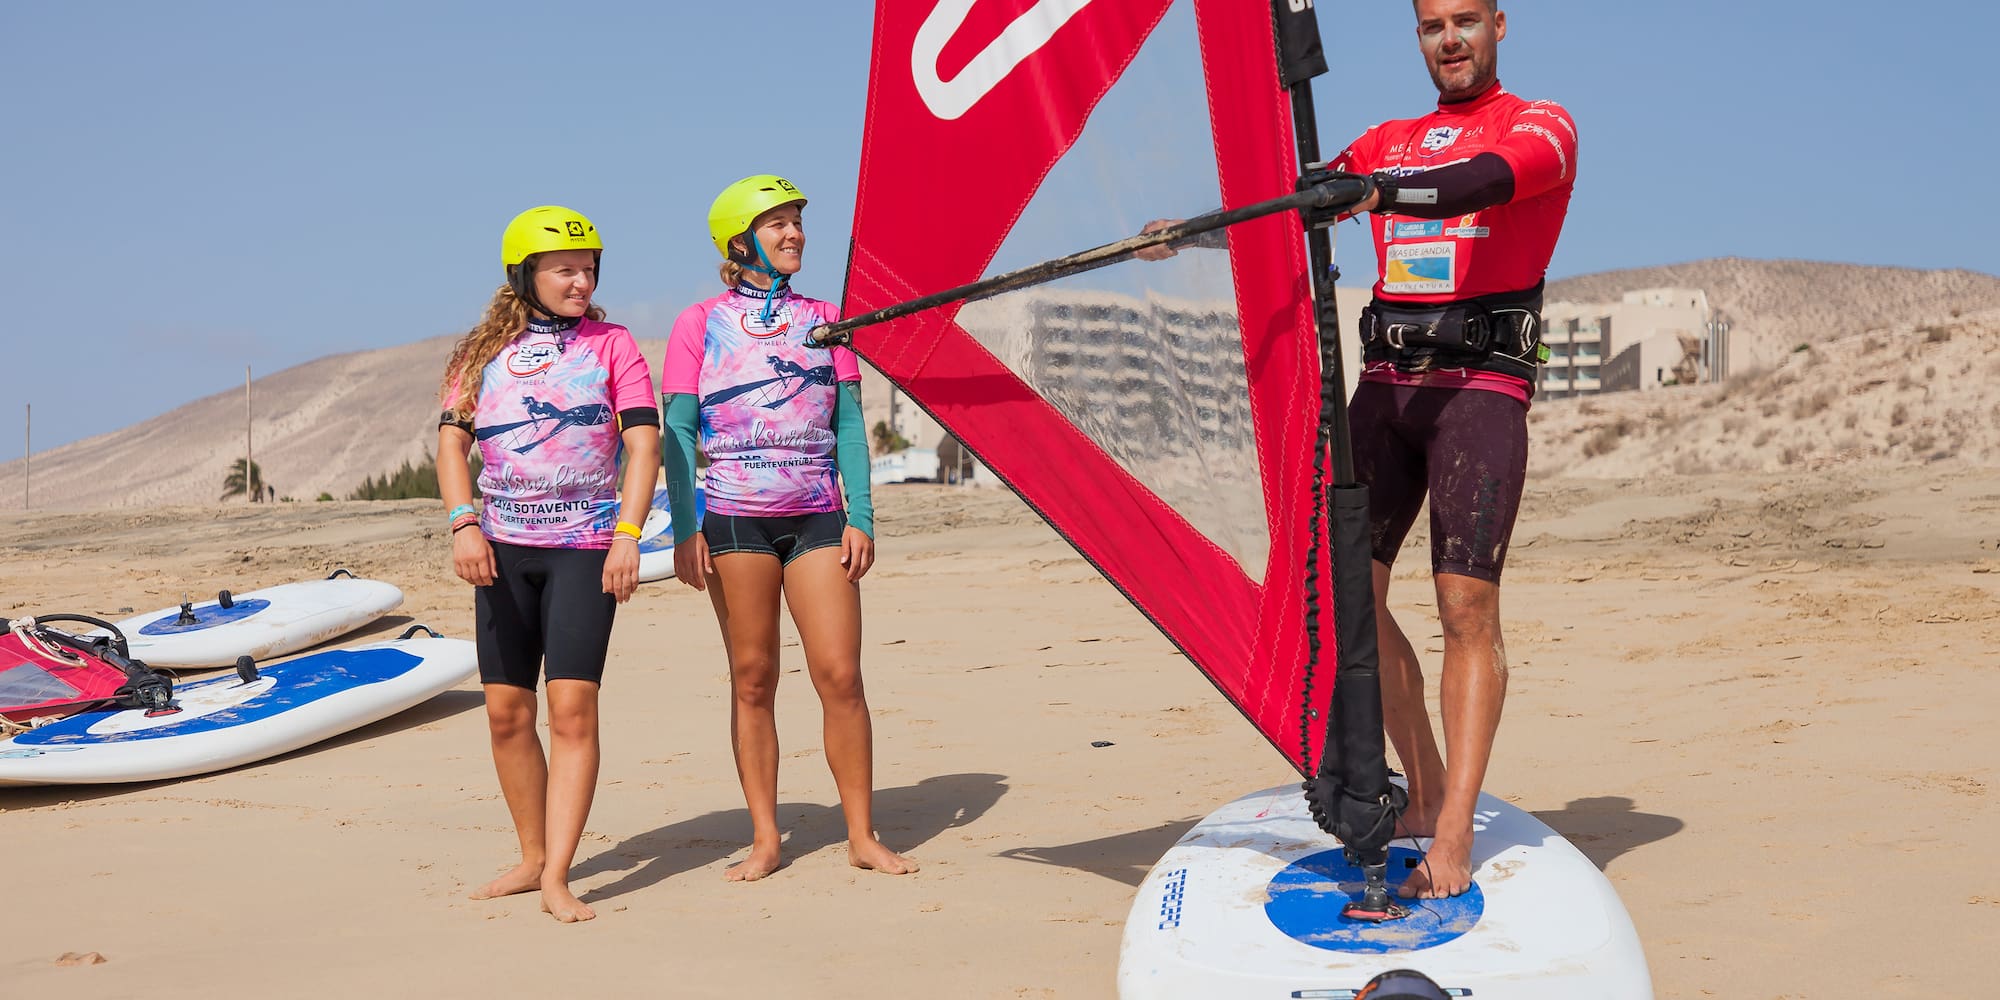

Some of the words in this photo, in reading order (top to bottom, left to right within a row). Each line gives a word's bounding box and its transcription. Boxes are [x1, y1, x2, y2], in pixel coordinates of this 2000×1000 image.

[1409, 248, 1419, 256] DE
[514, 500, 590, 514] SOTAVENTO
[500, 513, 568, 525] FUERTEVENTURA
